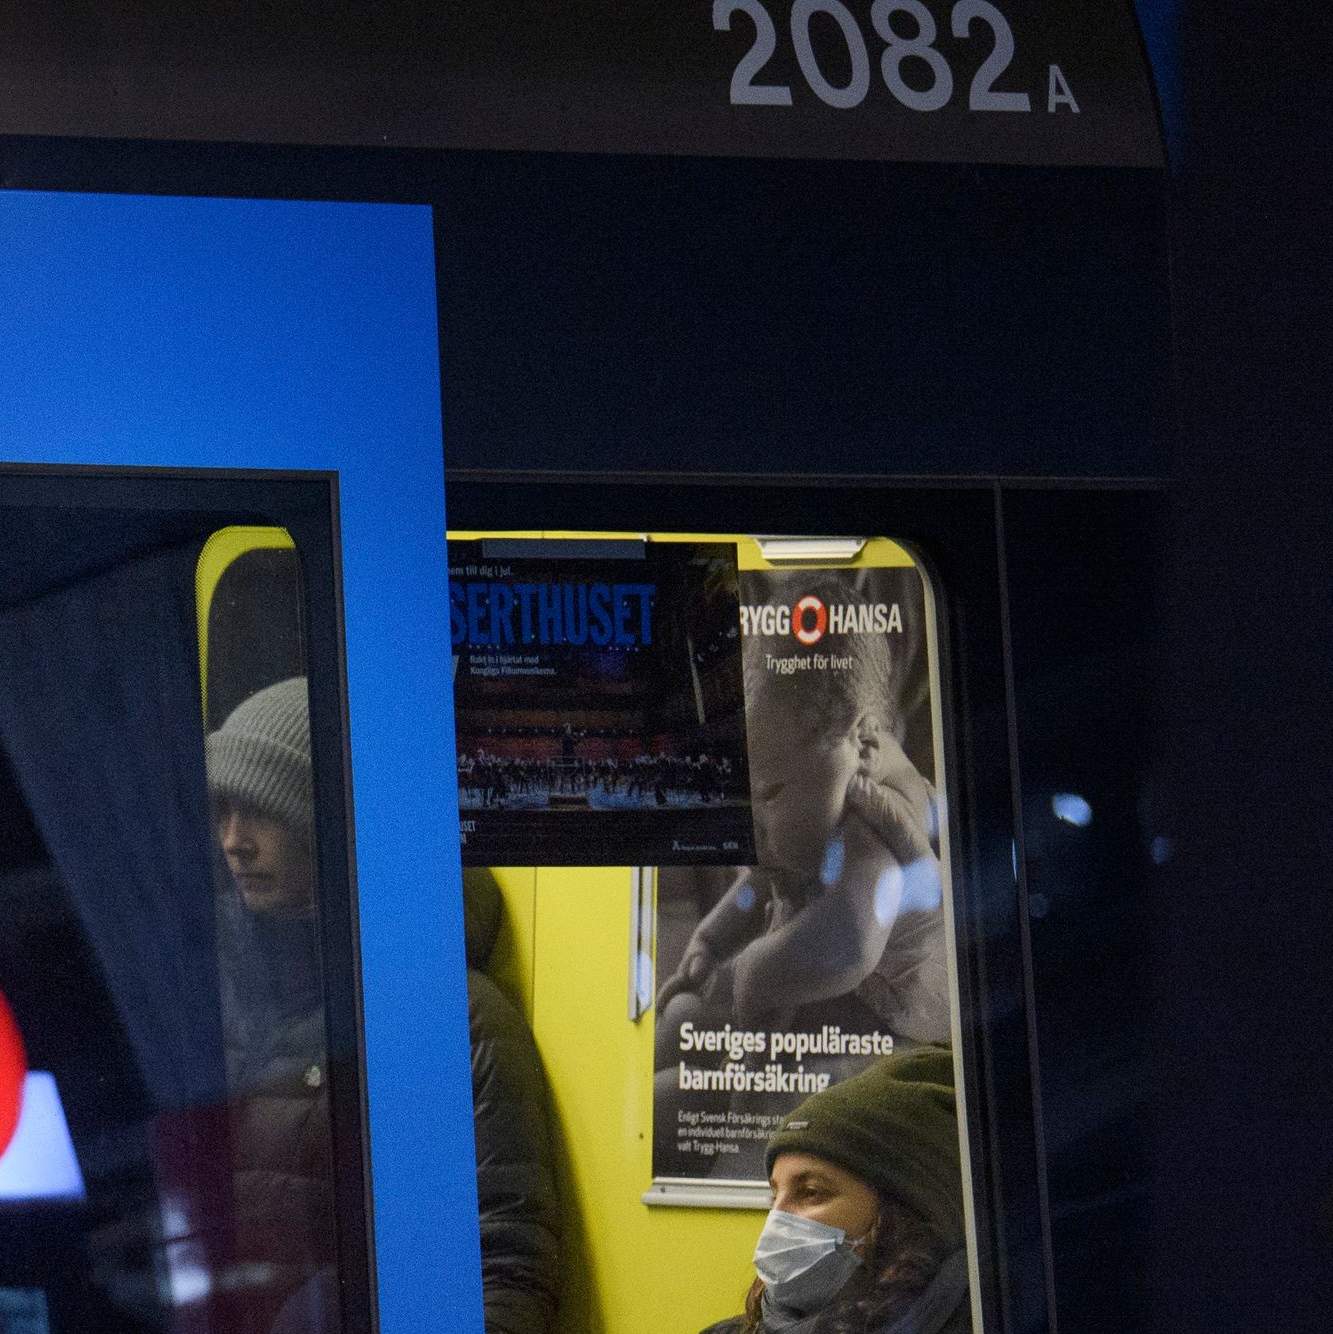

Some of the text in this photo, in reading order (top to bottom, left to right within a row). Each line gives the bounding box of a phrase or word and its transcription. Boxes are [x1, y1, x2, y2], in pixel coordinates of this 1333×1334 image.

[712, 0, 1080, 113] 2082 A
[479, 565, 492, 577] dig
[829, 604, 903, 634] HANSA
[766, 653, 853, 675] Trygghet för livet
[679, 1022, 893, 1061] Sveriges populäraste
[679, 1061, 830, 1092] barnförsäkring
[678, 1110, 699, 1125] Enligt
[700, 1111, 726, 1123] Svensk
[727, 1112, 771, 1127] Försäkrings
[677, 1128, 687, 1137] en
[688, 1127, 724, 1138] individuell
[677, 1141, 692, 1152] valt
